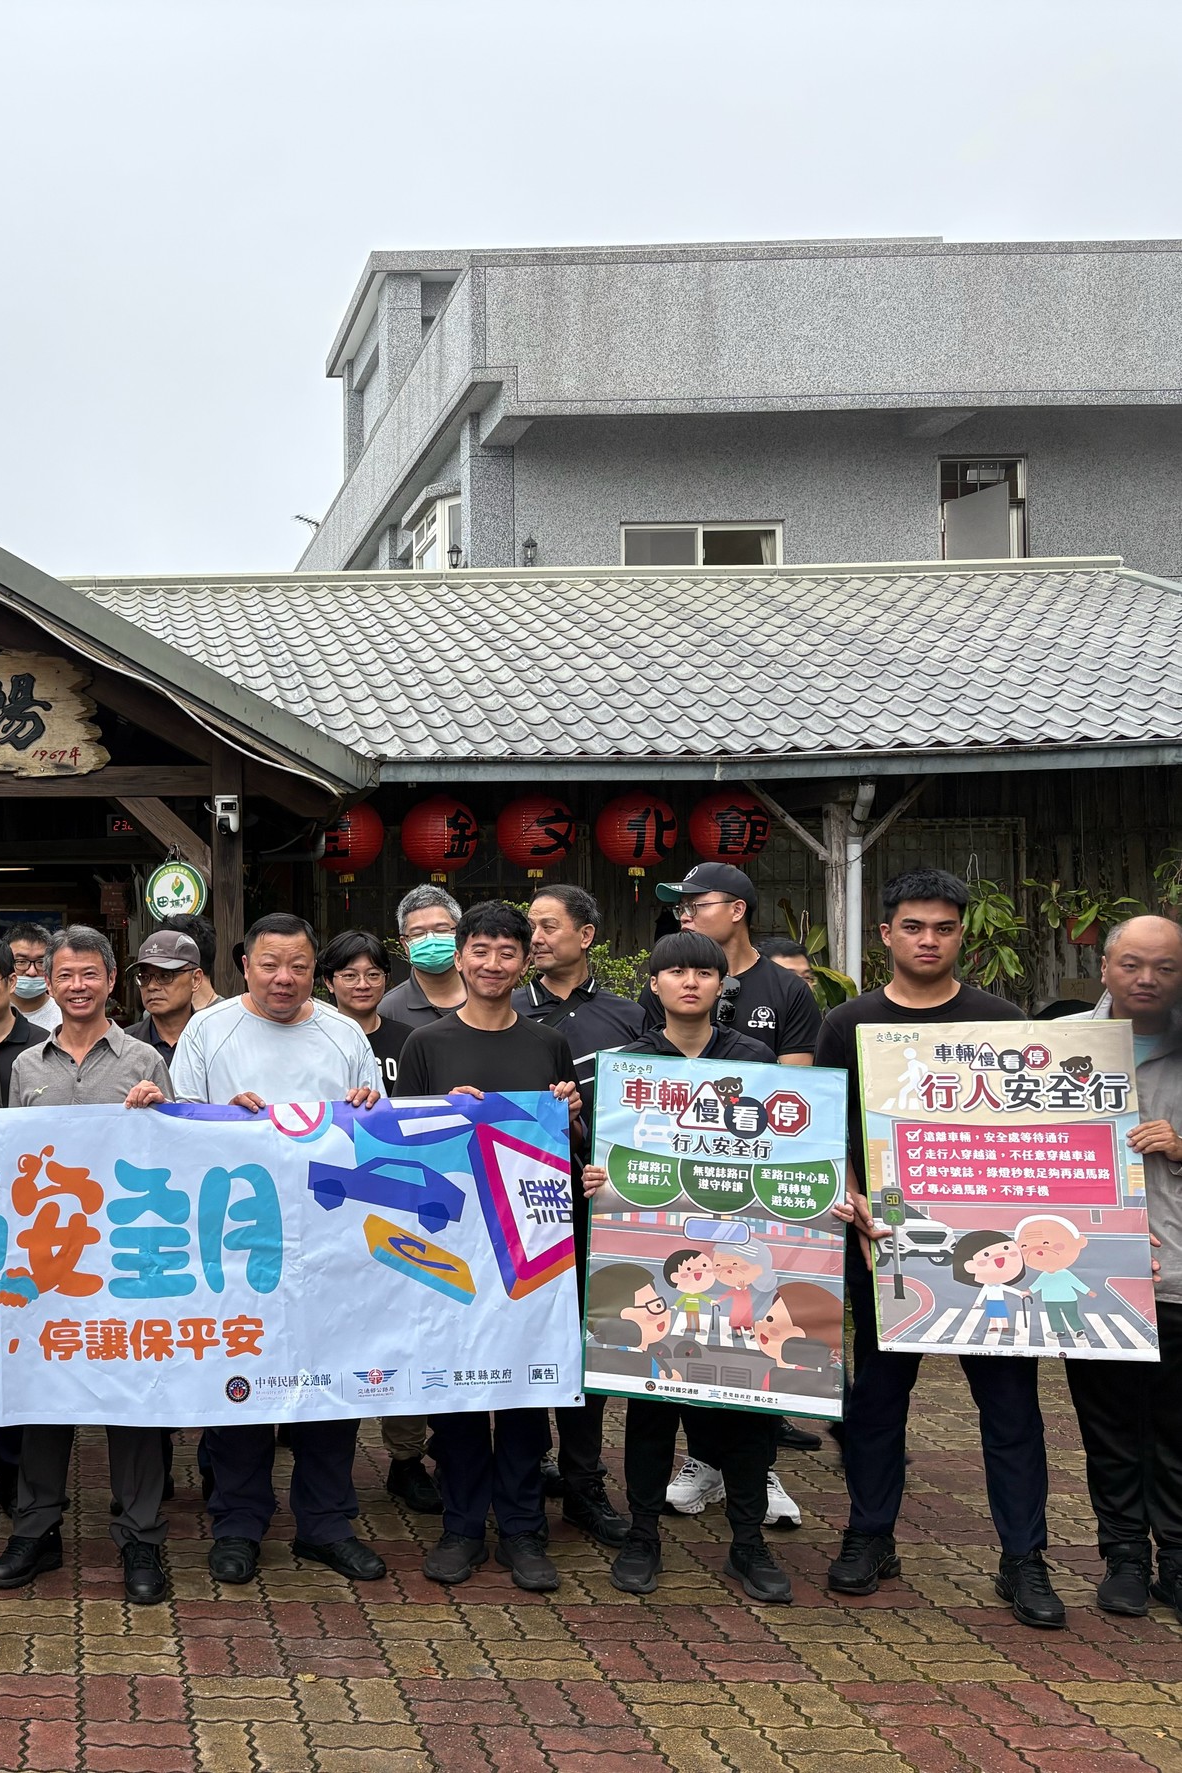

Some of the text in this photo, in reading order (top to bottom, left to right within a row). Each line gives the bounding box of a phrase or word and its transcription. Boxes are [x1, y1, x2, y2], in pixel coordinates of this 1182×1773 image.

[31, 746, 82, 766] 1967年
[747, 1020, 776, 1029] CPU
[921, 1073, 1128, 1111] 行人安全行
[672, 1133, 773, 1160] 行人安全行
[627, 1159, 672, 1174] 行經路口
[693, 1164, 749, 1180] 無號誌路口
[626, 1173, 672, 1187] 停讓行人
[760, 1168, 830, 1185] 至路口中心點
[697, 1179, 744, 1193] 遵守停讓
[777, 1183, 812, 1197] 再轉彎
[771, 1195, 817, 1210] 避免死角
[886, 1194, 899, 1205] 50
[255, 1373, 332, 1389] 中華民國交通部
[453, 1368, 512, 1381] 臺東縣政府
[531, 1368, 555, 1380] 廣告
